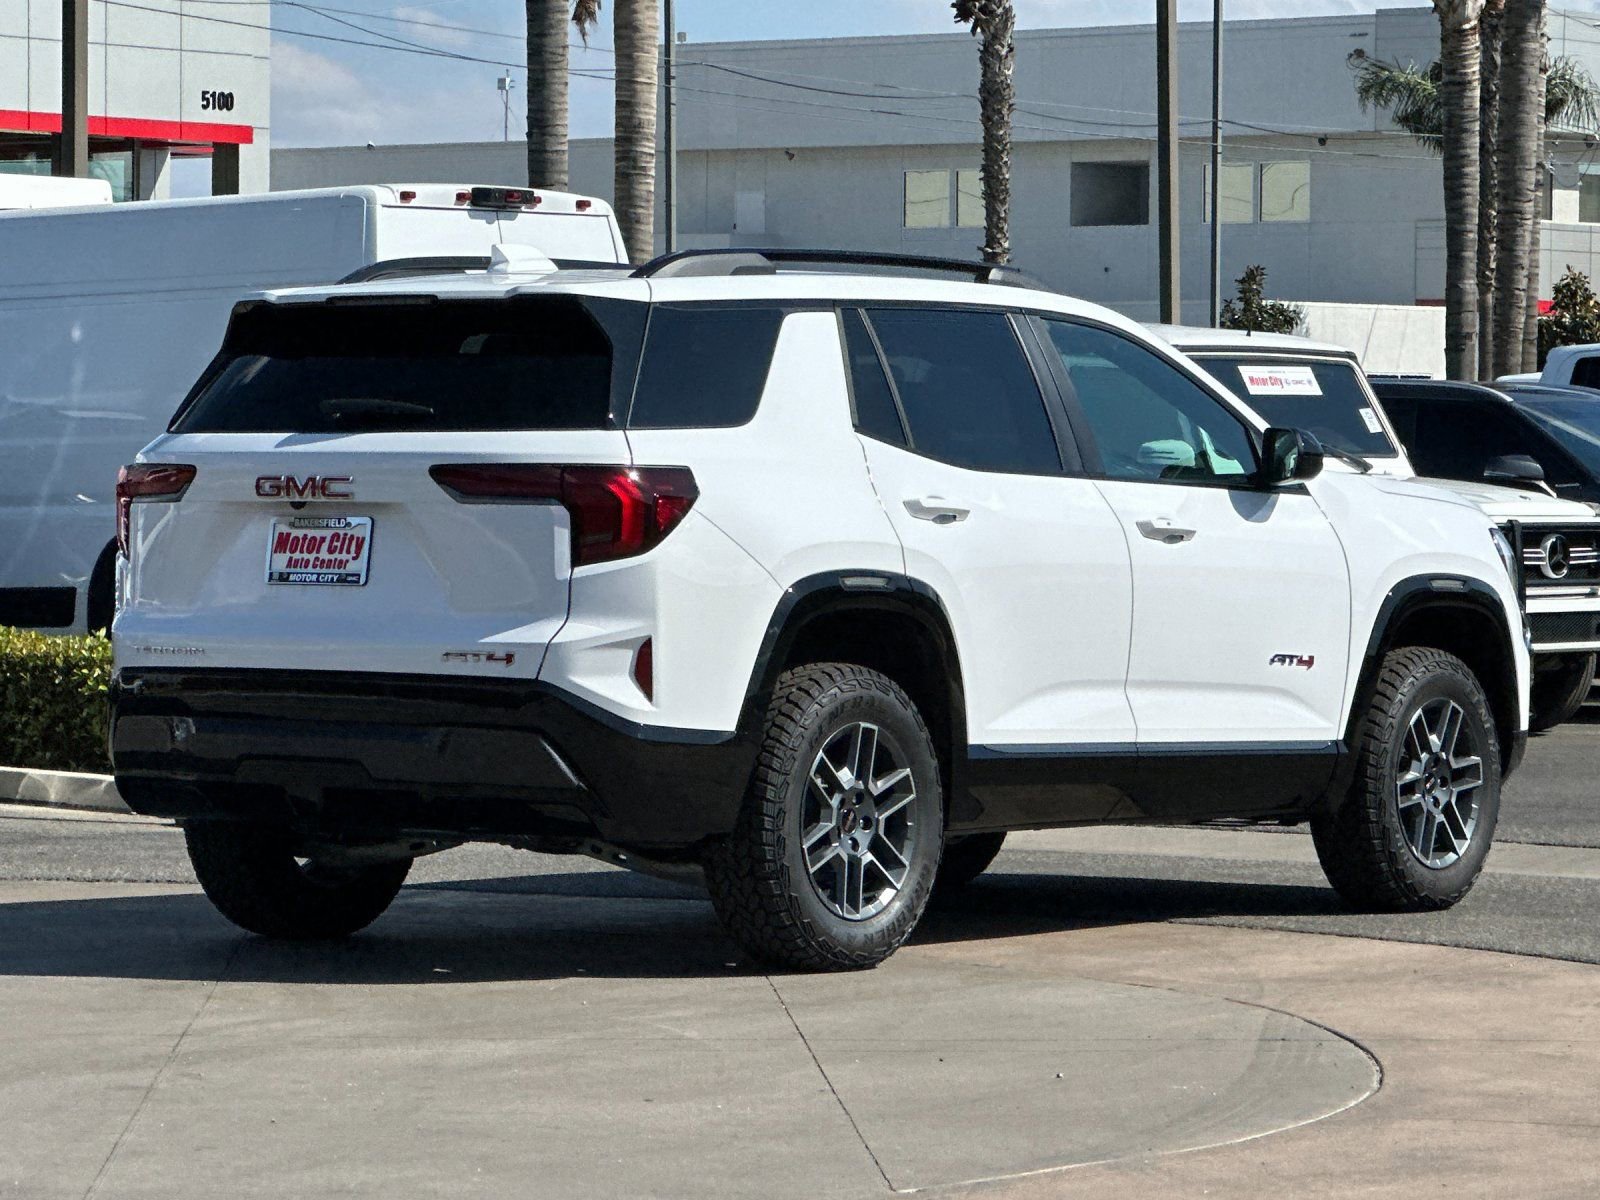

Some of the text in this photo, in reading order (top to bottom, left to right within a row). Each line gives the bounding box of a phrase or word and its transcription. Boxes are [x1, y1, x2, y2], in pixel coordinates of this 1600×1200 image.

[201, 90, 234, 111] 5100
[1248, 376, 1284, 389] Motor City
[255, 475, 353, 498] GMC
[294, 518, 346, 528] BAKERSFIELD
[273, 531, 366, 561] Motor City
[285, 556, 349, 570] Auto Center
[289, 573, 339, 582] MOTOR CITY
[1269, 653, 1315, 671] AT4
